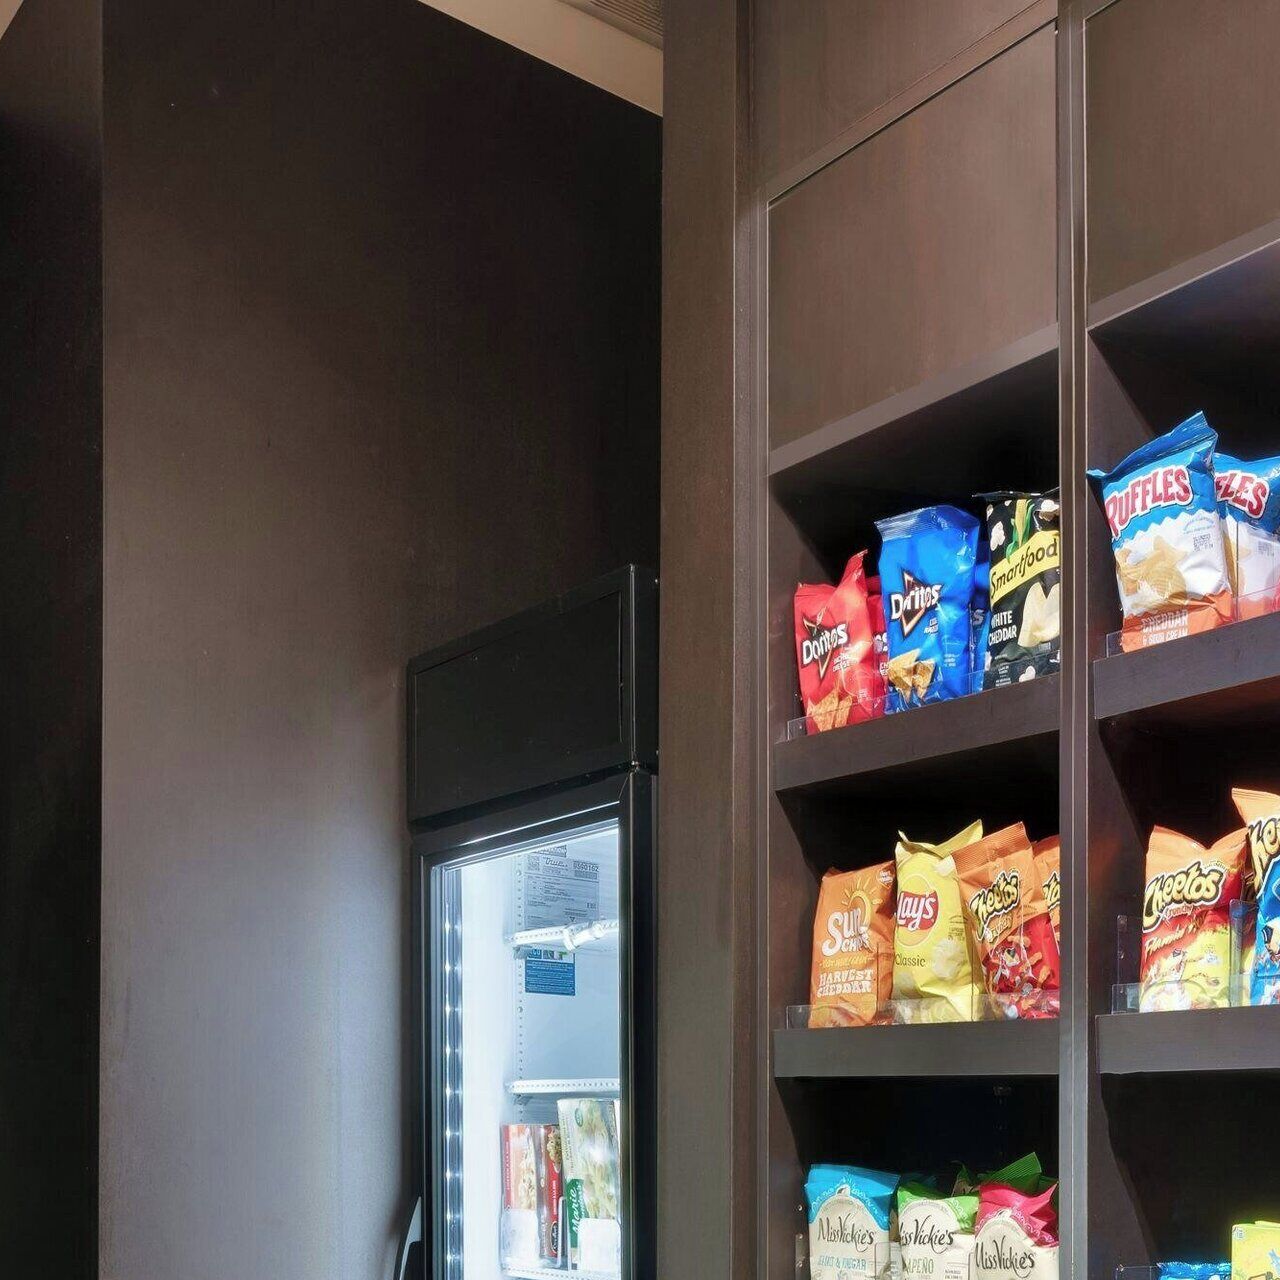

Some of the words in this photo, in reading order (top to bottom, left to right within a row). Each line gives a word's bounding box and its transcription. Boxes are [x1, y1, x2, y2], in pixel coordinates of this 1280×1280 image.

[1104, 467, 1192, 537] RUFFLES
[990, 538, 1058, 600] Smartfood
[891, 585, 941, 620] Doritos
[991, 610, 1013, 629] WHITE
[802, 624, 848, 665] Doritos
[988, 625, 1018, 646] CHEDDAR
[896, 891, 937, 931] Lay's
[1142, 860, 1225, 931] Cheetos
[819, 968, 874, 987] HARVEST
[895, 953, 927, 968] Classic
[816, 980, 872, 998] CHEDDAR
